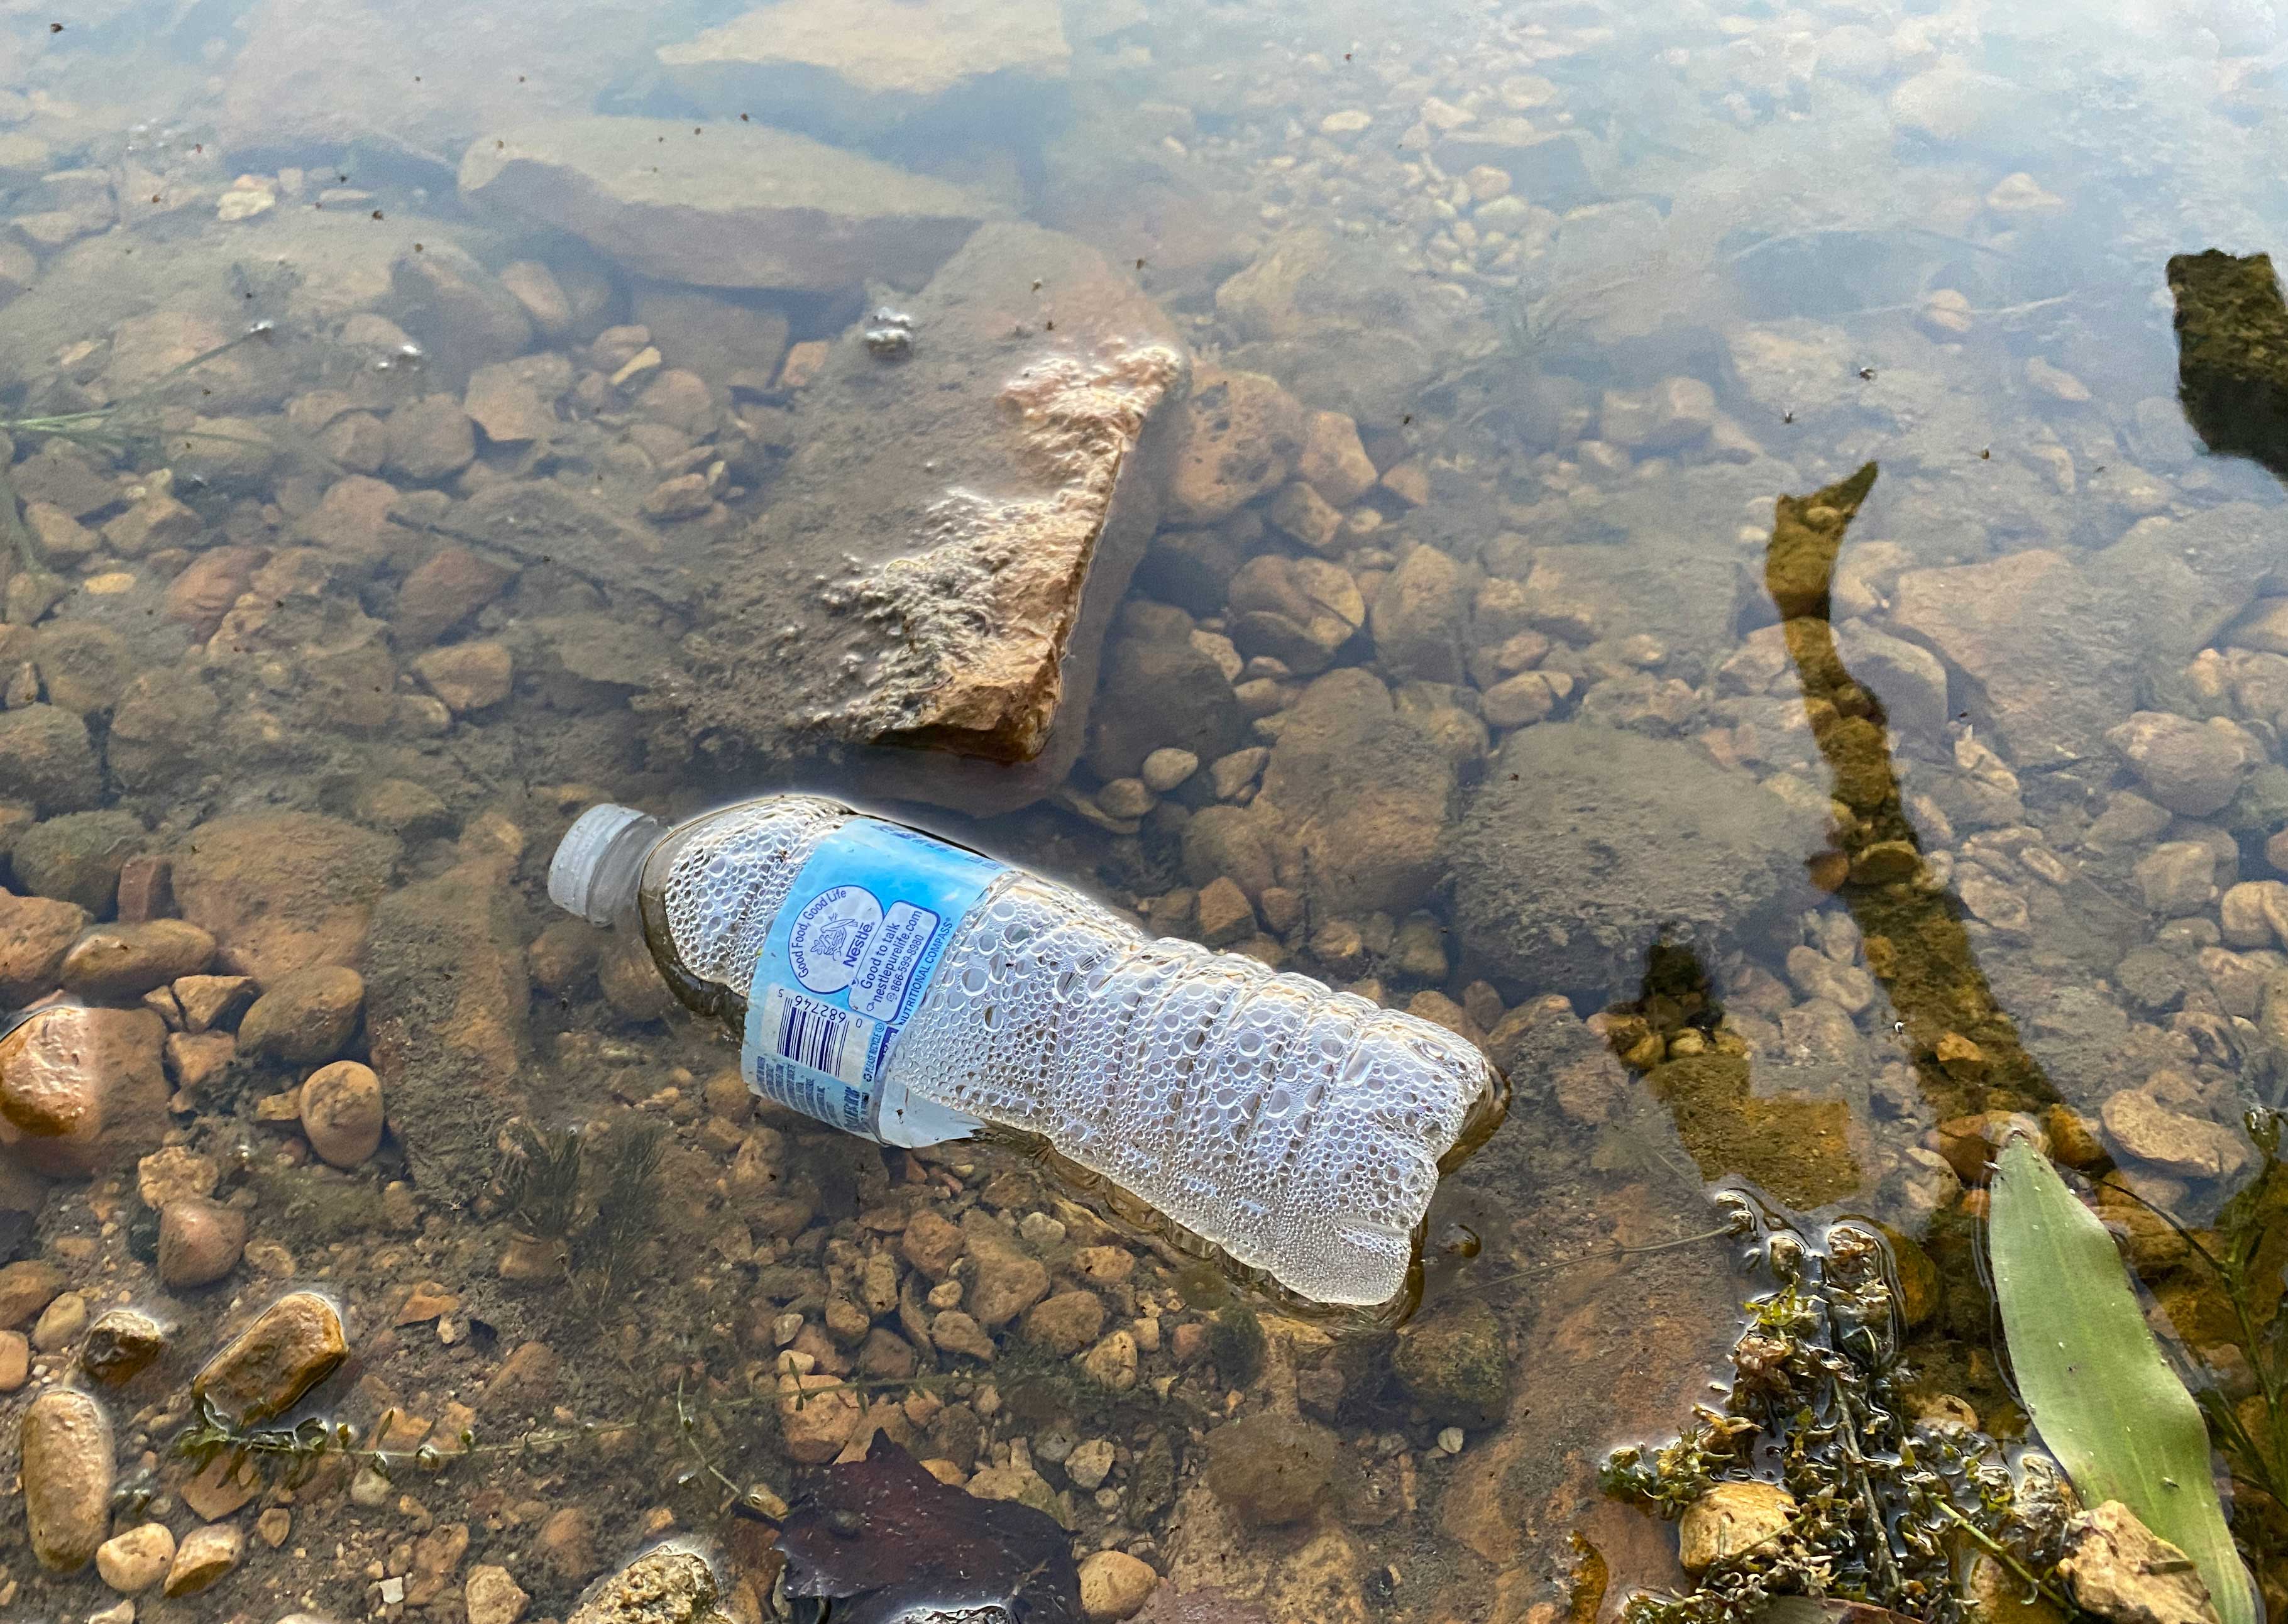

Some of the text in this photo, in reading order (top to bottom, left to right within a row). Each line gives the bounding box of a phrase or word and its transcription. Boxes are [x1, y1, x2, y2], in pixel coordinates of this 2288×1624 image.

[792, 889, 847, 979] Good Food, Good Life
[861, 923, 900, 989] Good to talk
[873, 911, 923, 1003] nestlepurelife.com
[891, 935, 924, 992] 866-599-8980
[778, 989, 863, 1028] 0 682746 5
[899, 965, 932, 1025] NUTRITIONAL
